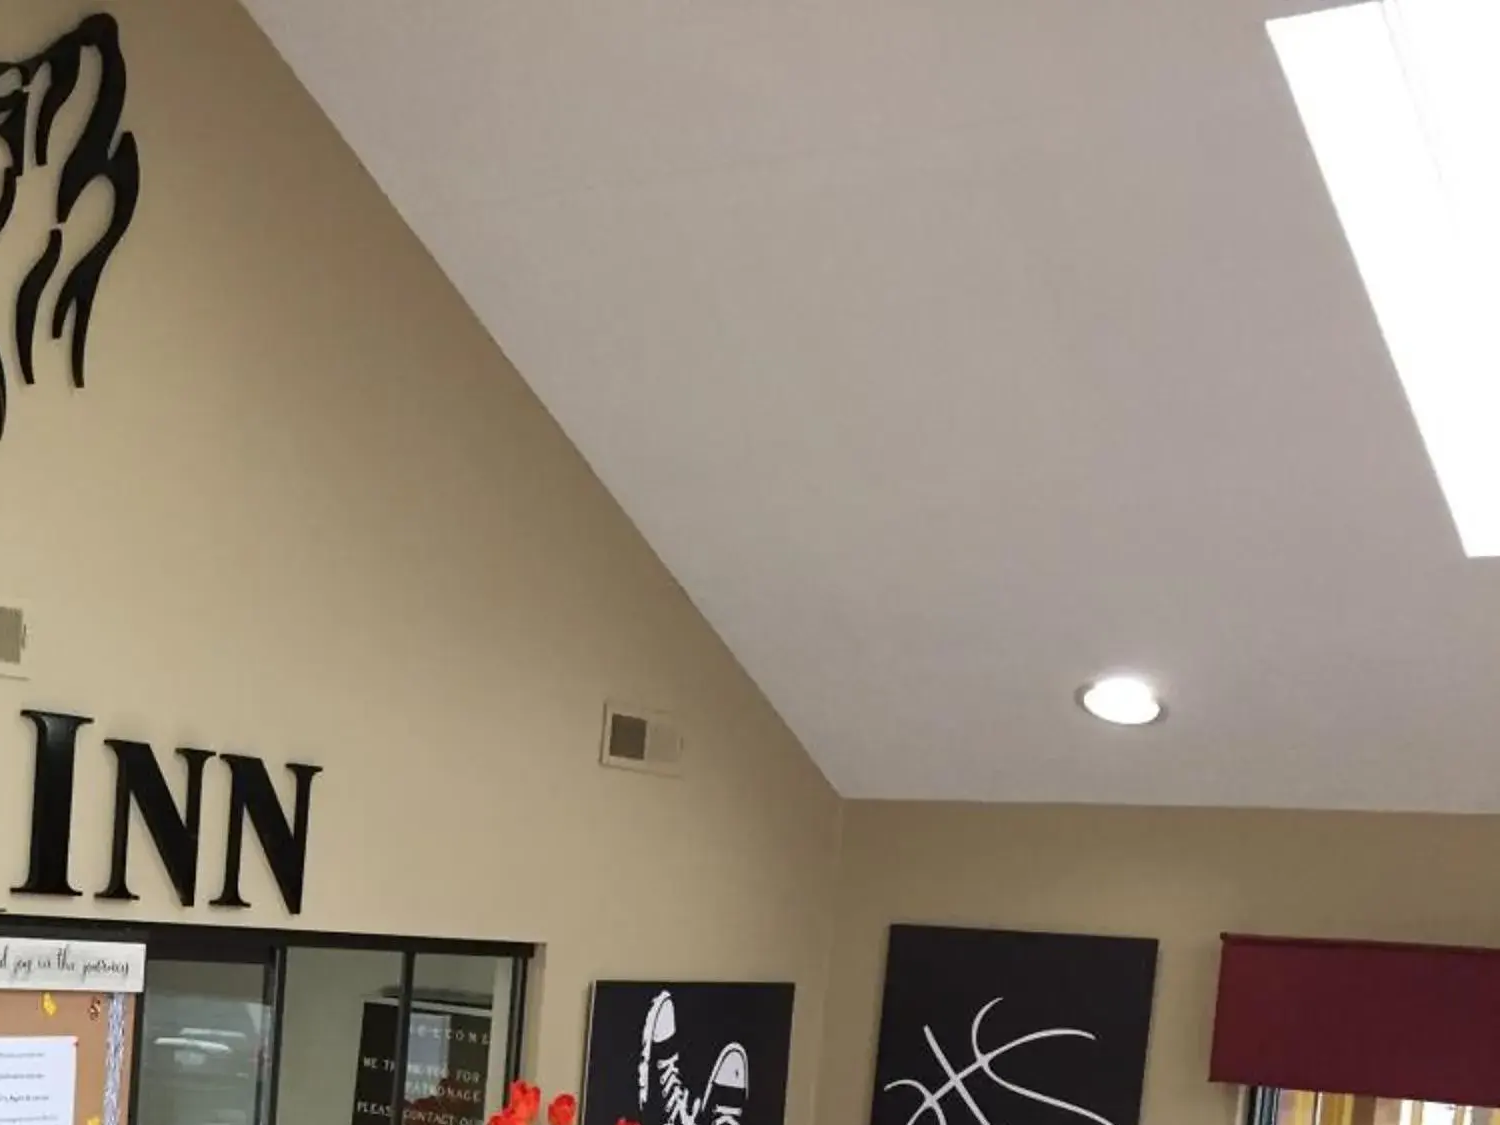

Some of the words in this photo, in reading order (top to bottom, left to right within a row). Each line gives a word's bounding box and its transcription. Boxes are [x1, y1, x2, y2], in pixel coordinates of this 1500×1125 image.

[10, 708, 323, 916] INN
[11, 956, 34, 982] joy
[55, 943, 76, 972] the
[408, 1024, 492, 1046] ELCOME
[455, 1069, 481, 1083] FOR
[357, 1101, 393, 1116] PLEAS
